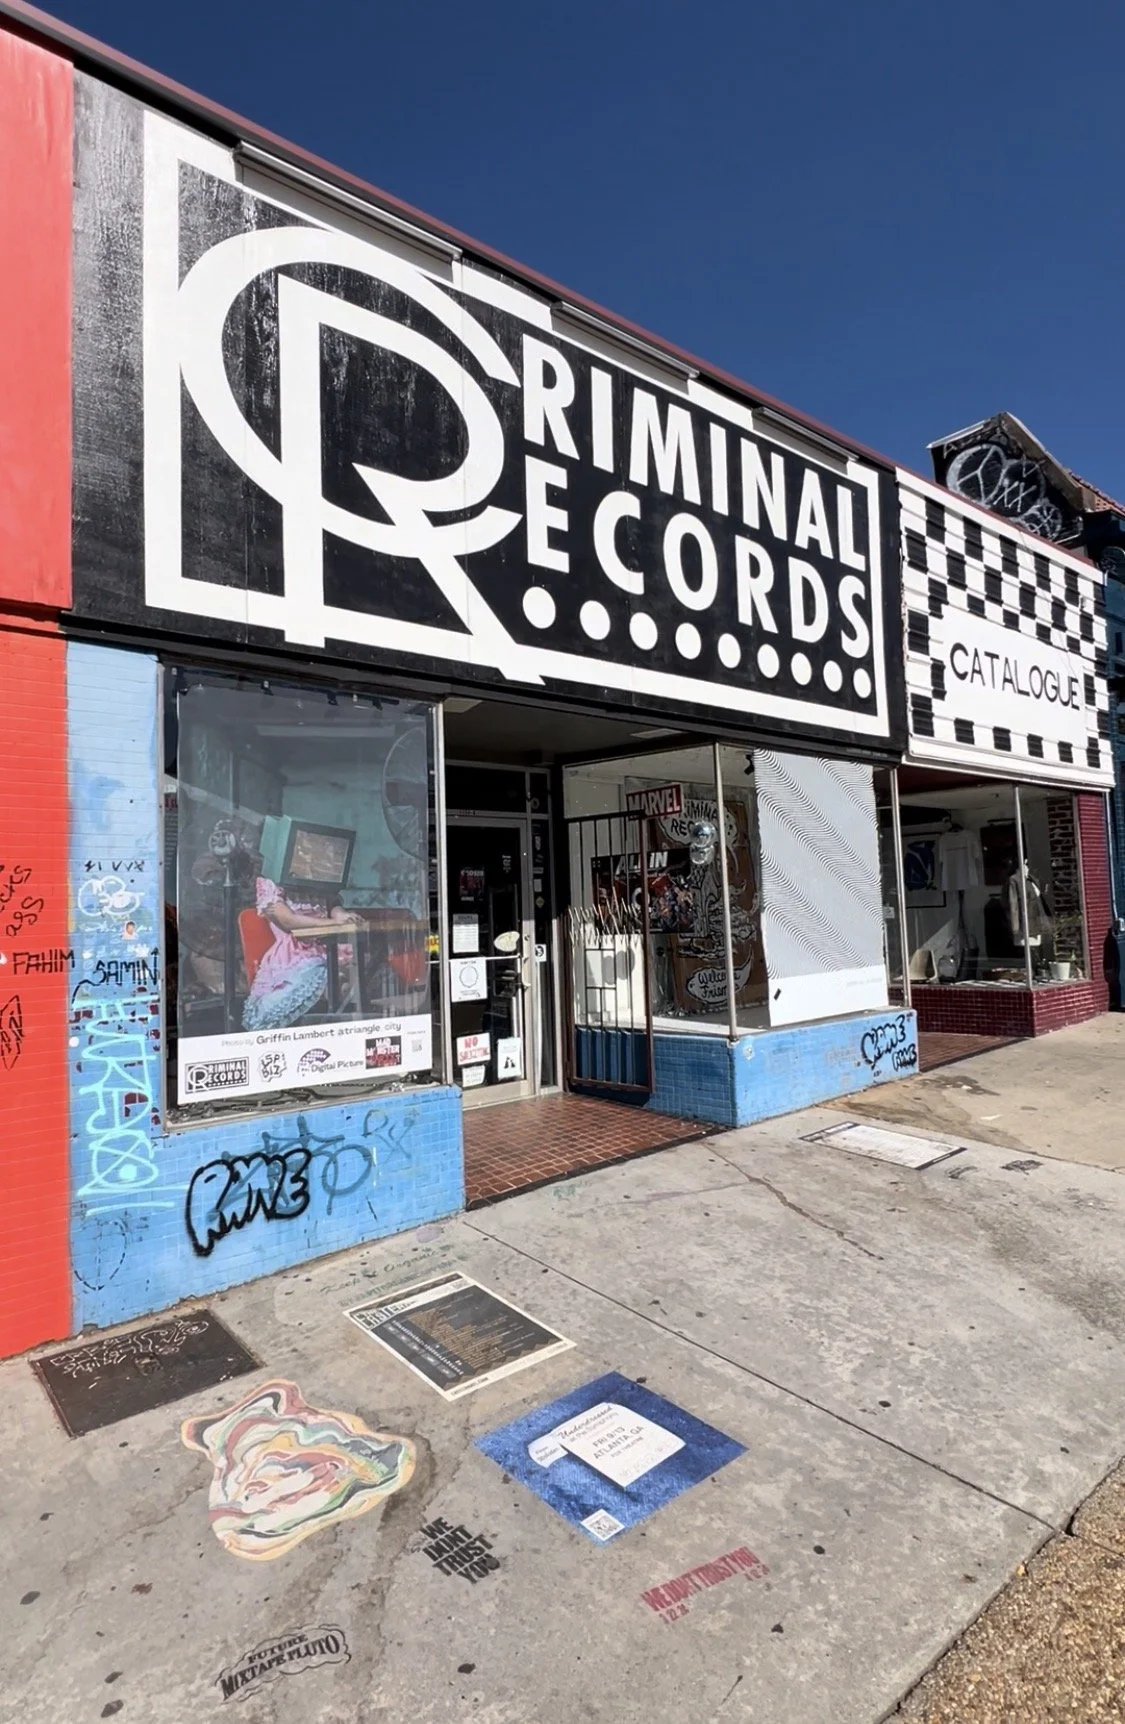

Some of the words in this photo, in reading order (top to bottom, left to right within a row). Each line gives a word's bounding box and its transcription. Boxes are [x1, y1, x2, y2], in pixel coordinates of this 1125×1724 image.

[950, 642, 1080, 711] CATALOGUE
[627, 787, 681, 816] MARVEL
[649, 851, 668, 868] IN
[12, 949, 75, 975] FAHIM
[94, 952, 160, 986] SAMIN
[698, 969, 741, 985] Welcoe
[256, 1032, 291, 1045] Griffin
[293, 1029, 334, 1041] Lambert
[464, 1036, 478, 1049] NO
[311, 1062, 336, 1073] Digital
[558, 1405, 613, 1440] Underdressed
[629, 1425, 645, 1436] GA
[592, 1435, 608, 1448] FRI
[419, 1516, 454, 1540] WE
[432, 1534, 494, 1577] TRUST
[640, 1587, 673, 1612] WE
[691, 1557, 737, 1588] TRUST
[725, 1546, 760, 1571] YOU
[247, 1634, 308, 1665] FUTURE
[220, 1655, 287, 1702] MIXTAPE
[287, 1633, 340, 1662] PLUTO
